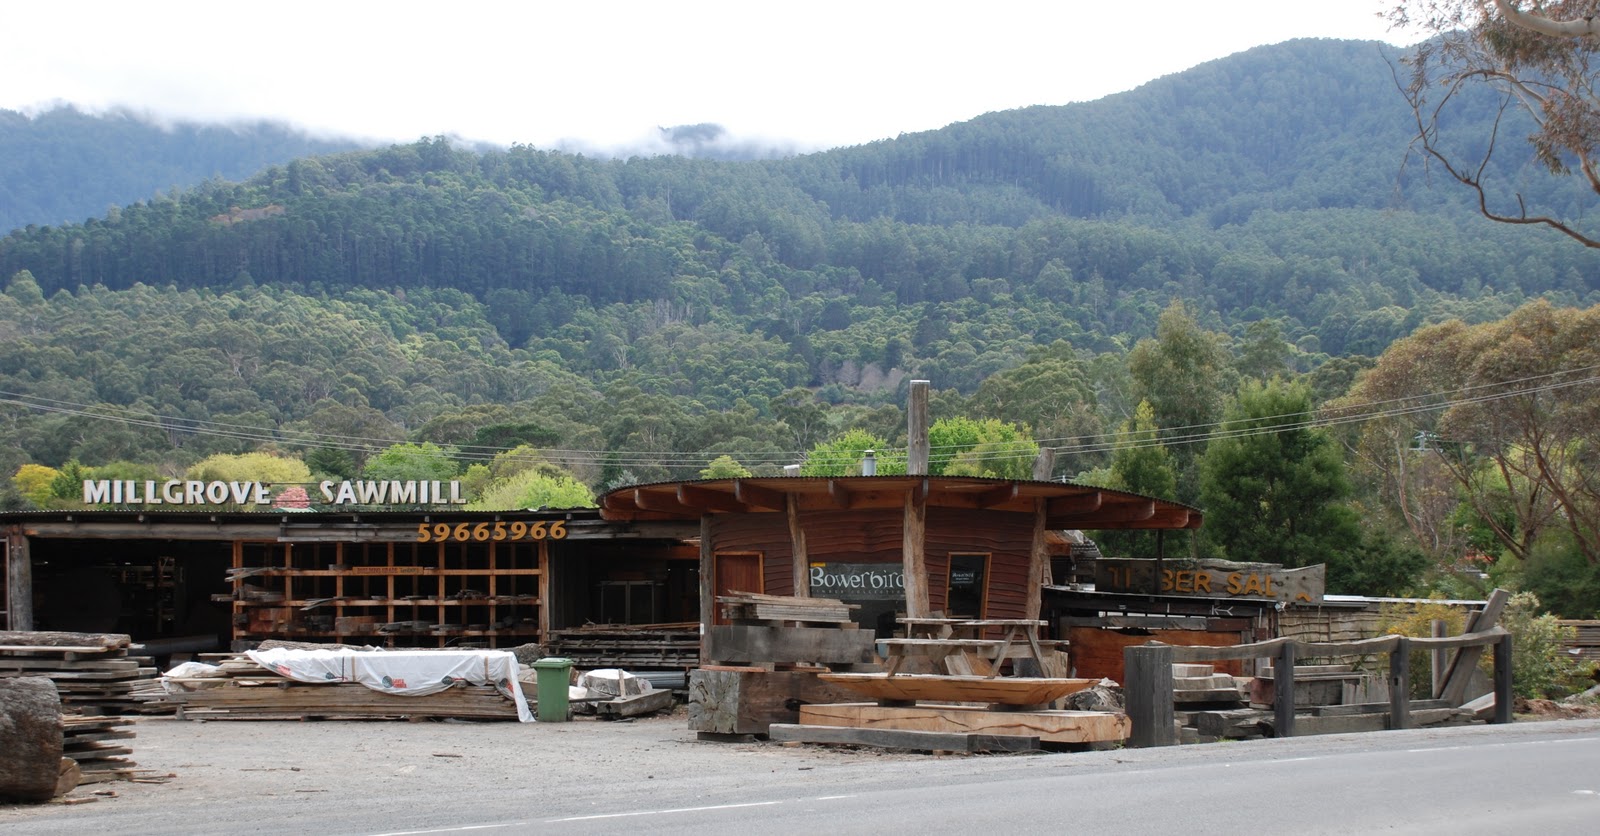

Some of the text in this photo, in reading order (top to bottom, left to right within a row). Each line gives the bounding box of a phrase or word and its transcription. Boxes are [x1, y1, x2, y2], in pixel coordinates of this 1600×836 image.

[83, 479, 467, 505] MILLGROVE SAWMILL
[416, 520, 567, 543] 59665966
